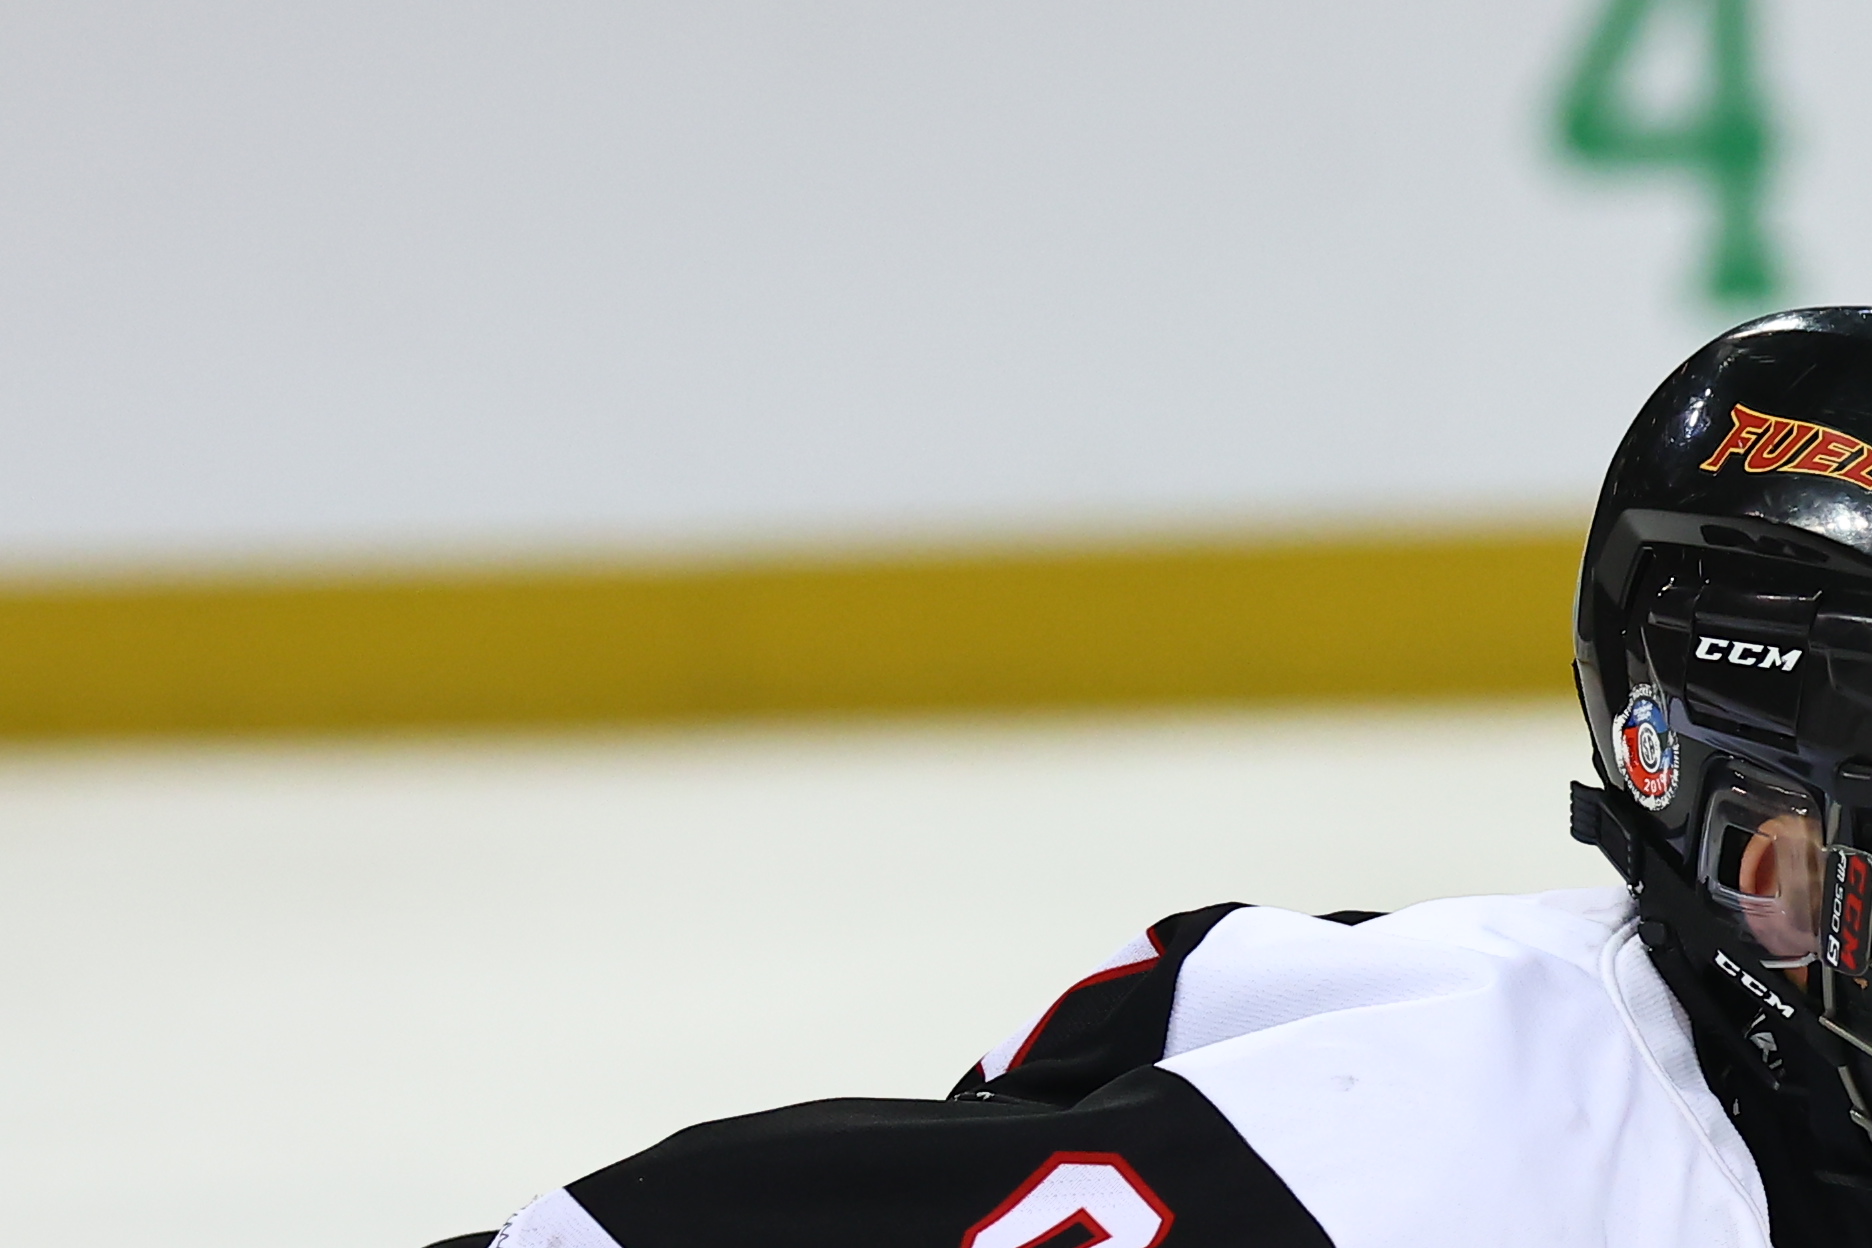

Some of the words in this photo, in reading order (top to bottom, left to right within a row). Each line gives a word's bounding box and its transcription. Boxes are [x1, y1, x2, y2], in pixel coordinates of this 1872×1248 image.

[1550, 0, 1782, 308] 4
[1695, 635, 1803, 672] CCM
[1831, 883, 1844, 934] 500
[1841, 854, 1868, 971] CCM
[1714, 949, 1795, 1019] CCM
